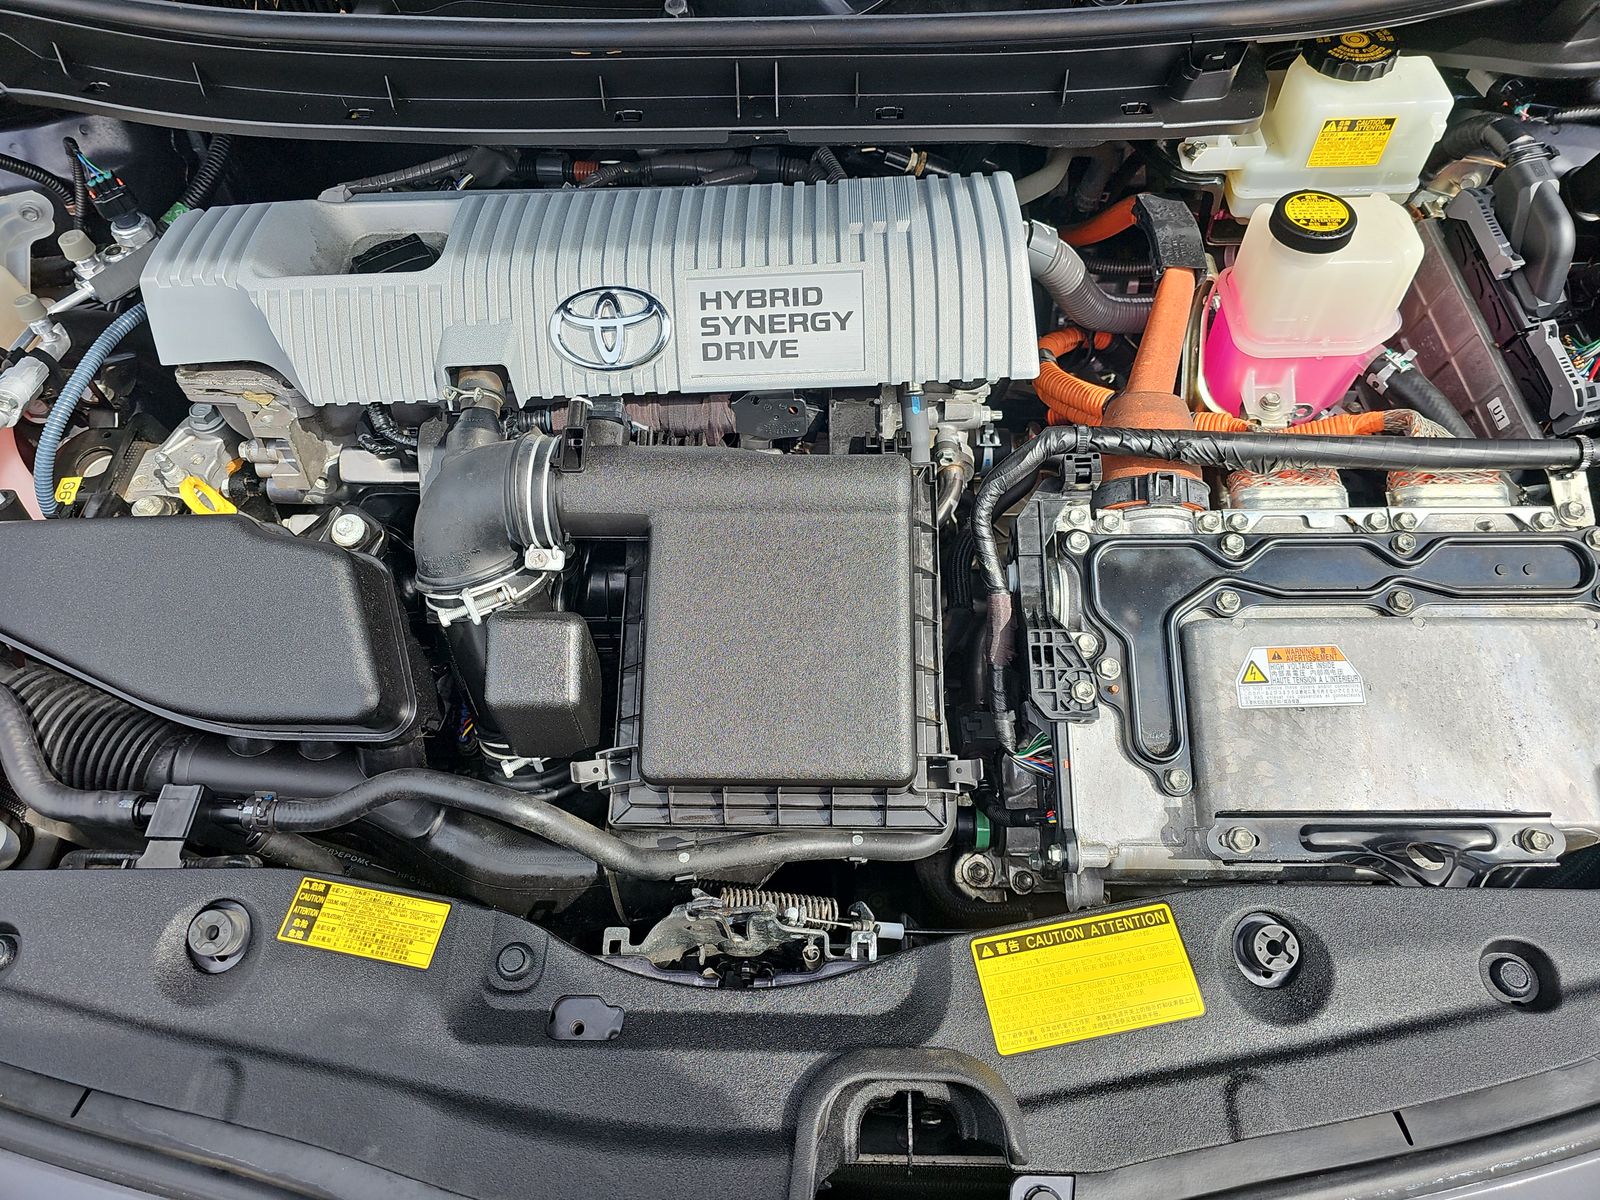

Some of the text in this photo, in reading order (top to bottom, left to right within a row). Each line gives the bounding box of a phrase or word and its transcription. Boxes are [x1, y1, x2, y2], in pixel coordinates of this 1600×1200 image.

[700, 287, 822, 310] HYBRID
[700, 311, 854, 336] SYNERGY
[702, 339, 799, 361] DRIVE
[1493, 405, 1505, 422] U1
[298, 892, 325, 903] CAUTION
[292, 905, 319, 916] ATTENTION
[994, 910, 1166, 954] 警告 CAUTION ATTENTION
